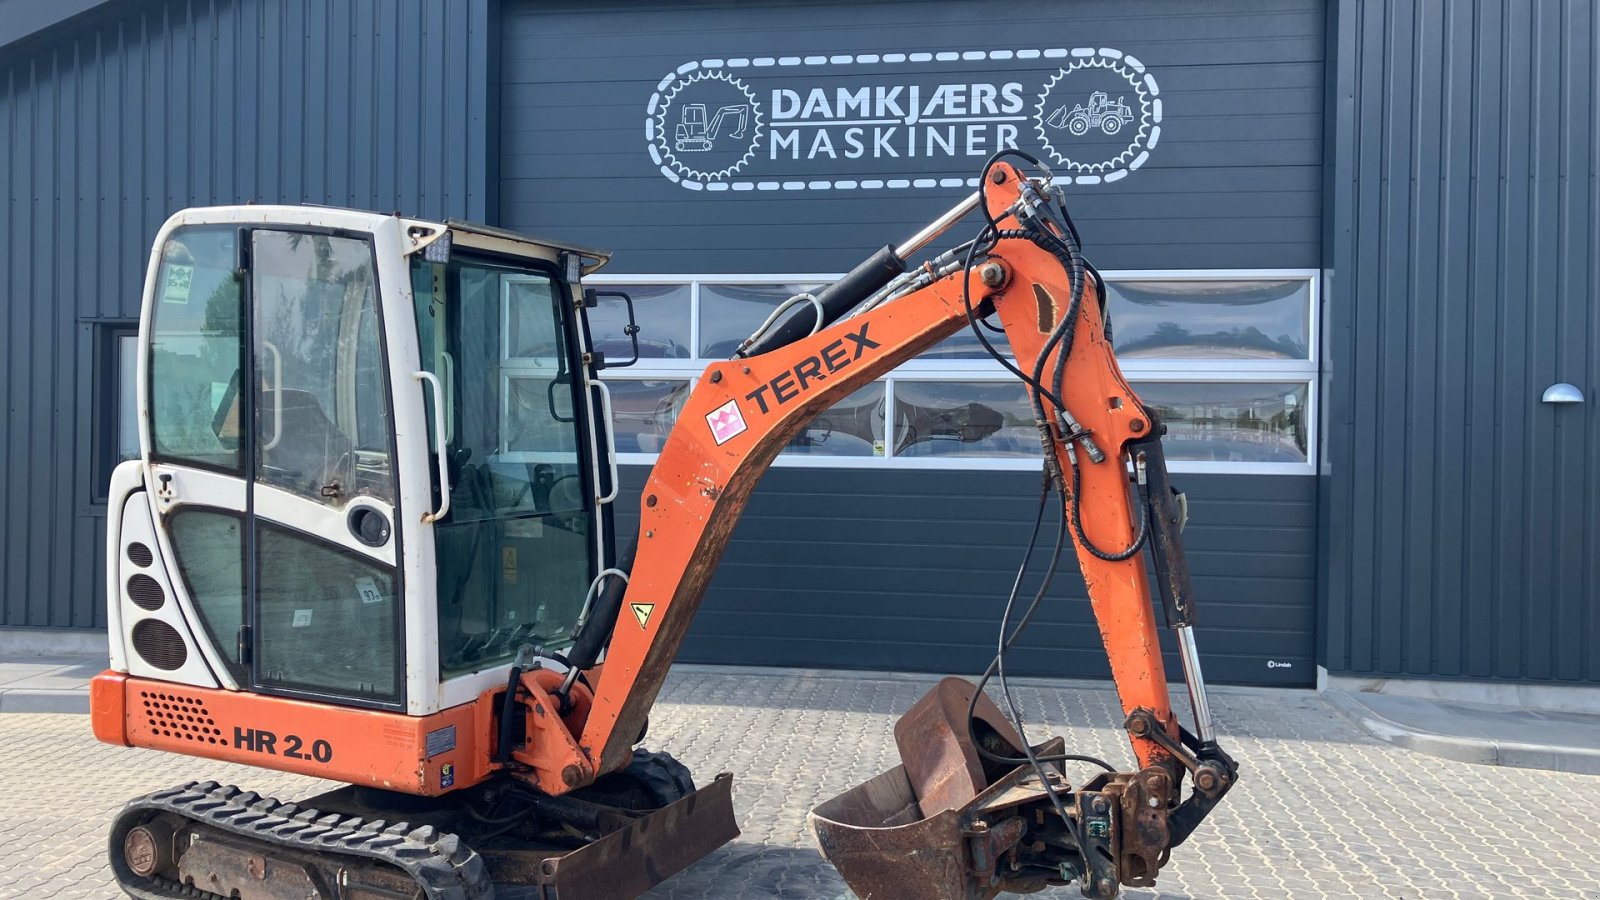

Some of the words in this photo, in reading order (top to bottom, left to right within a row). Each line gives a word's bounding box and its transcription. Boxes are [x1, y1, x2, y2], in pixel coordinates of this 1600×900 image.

[771, 82, 1024, 126] DAMKJÆRS
[769, 125, 1019, 160] MASKINER
[745, 321, 881, 415] TEREX
[234, 726, 277, 755] HR
[283, 733, 333, 763] 2.0
